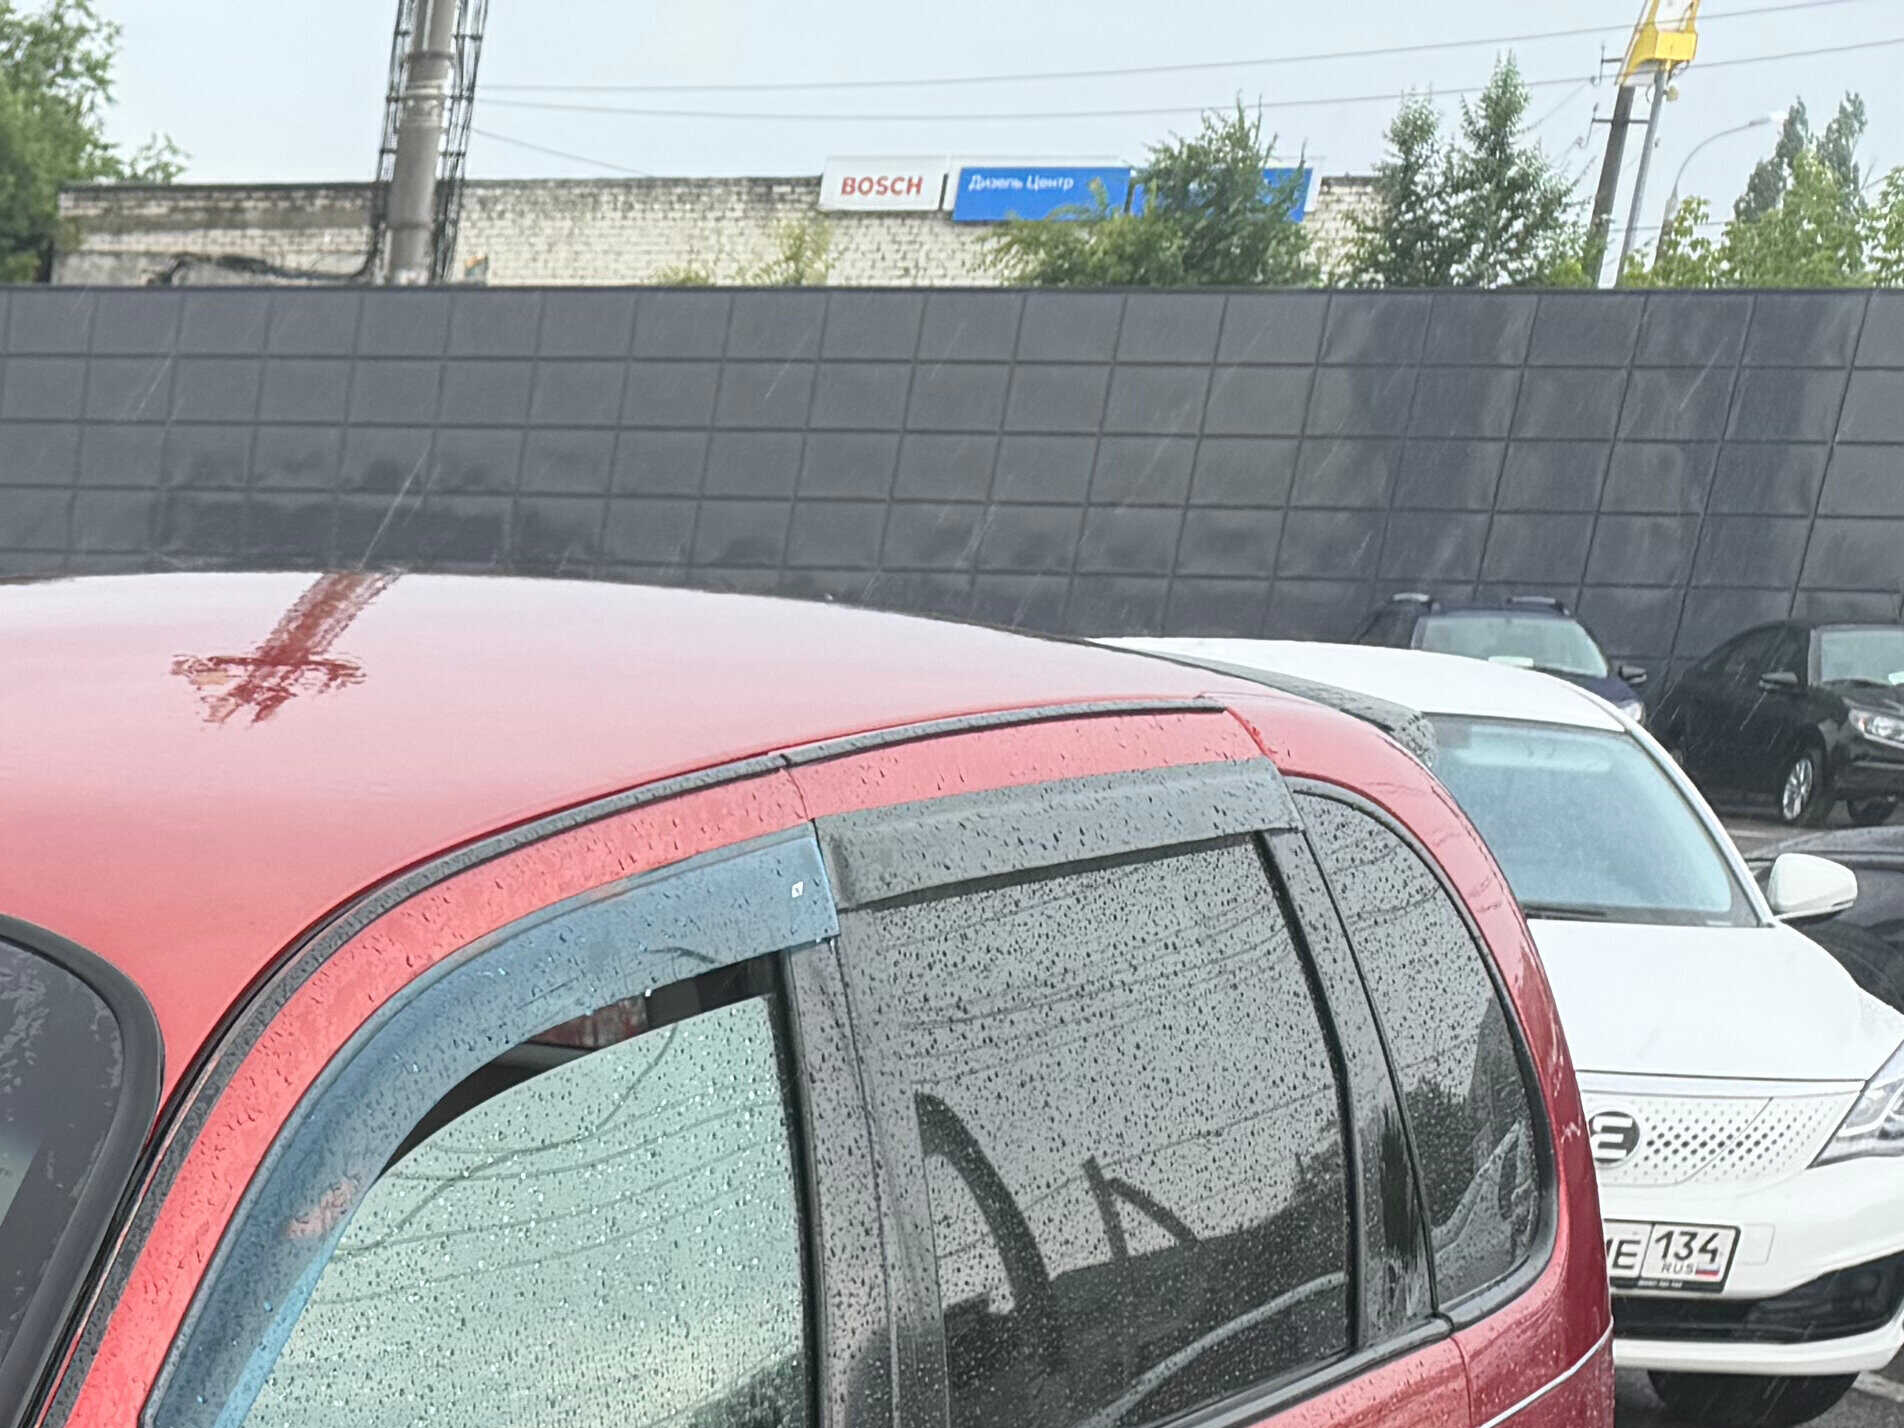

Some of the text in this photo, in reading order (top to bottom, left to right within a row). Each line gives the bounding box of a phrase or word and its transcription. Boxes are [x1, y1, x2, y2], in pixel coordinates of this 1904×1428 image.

[840, 176, 924, 196] BOSCH
[967, 174, 1075, 191] Дизель Центр
[1654, 1229, 1720, 1265] 134
[1661, 1261, 1694, 1275] RUS
